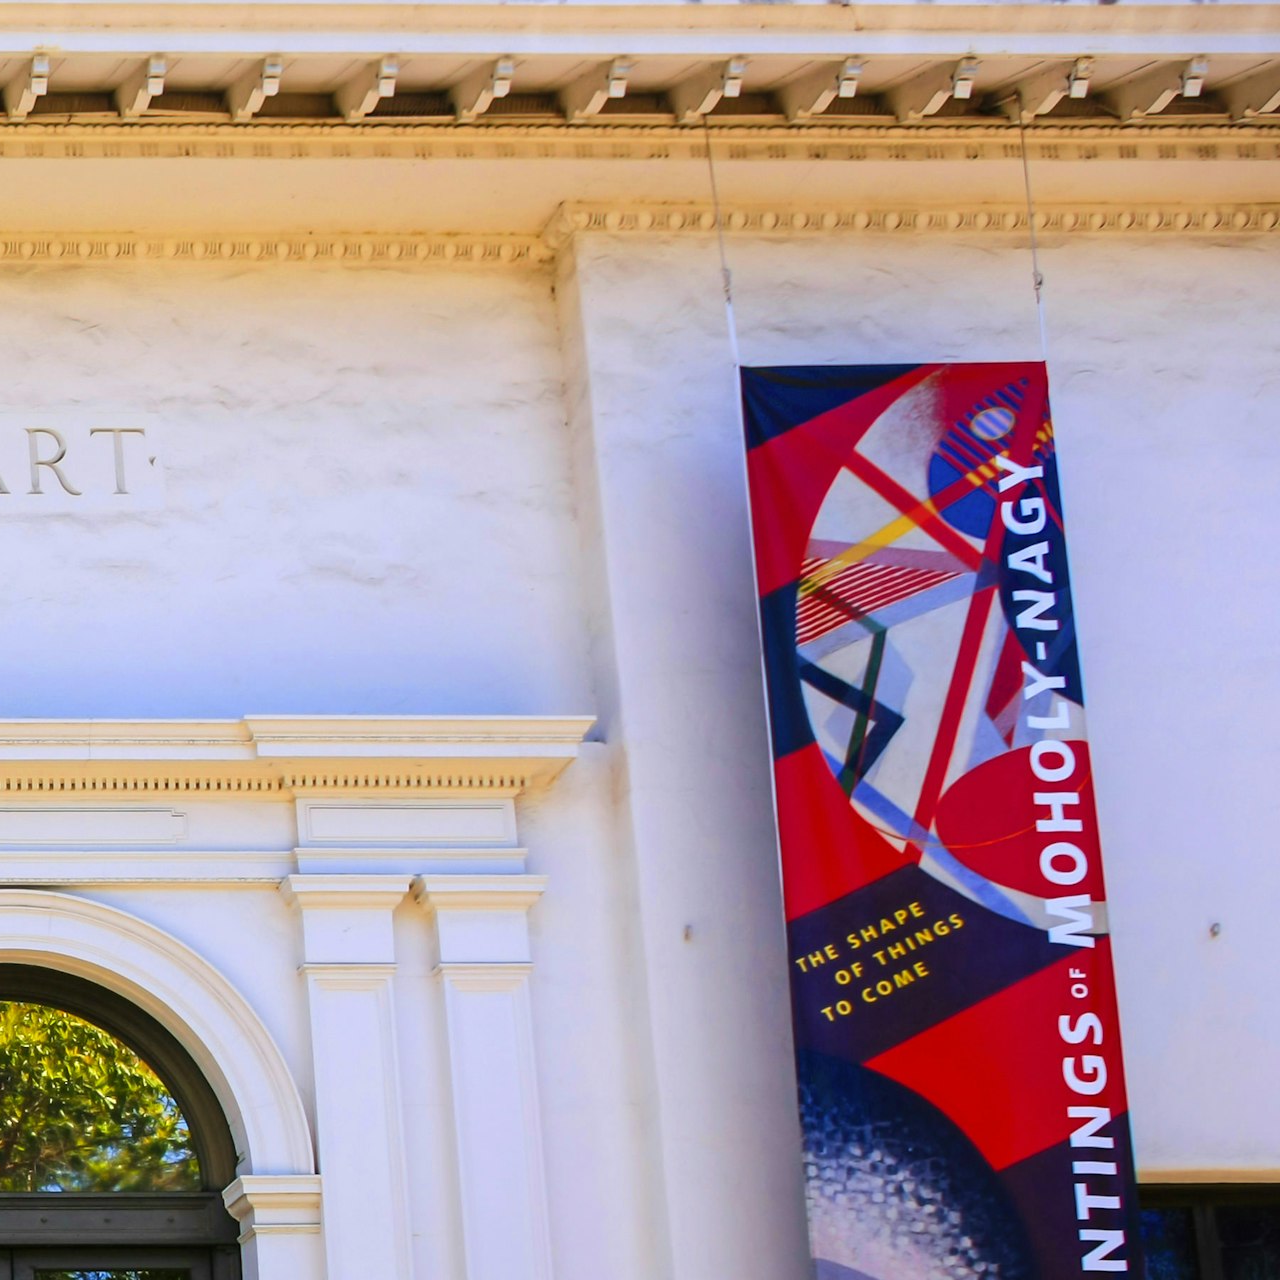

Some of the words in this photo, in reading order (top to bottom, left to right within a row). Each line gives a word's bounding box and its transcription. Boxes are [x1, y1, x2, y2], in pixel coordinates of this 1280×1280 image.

[996, 455, 1096, 948] MOHOLY-NAGY
[795, 944, 839, 973] THE
[846, 902, 925, 949] SHAPE
[834, 962, 864, 985] OF
[872, 913, 965, 966] THINGS
[821, 1000, 852, 1022] TO
[861, 962, 930, 1003] COME
[1070, 967, 1088, 999] OF
